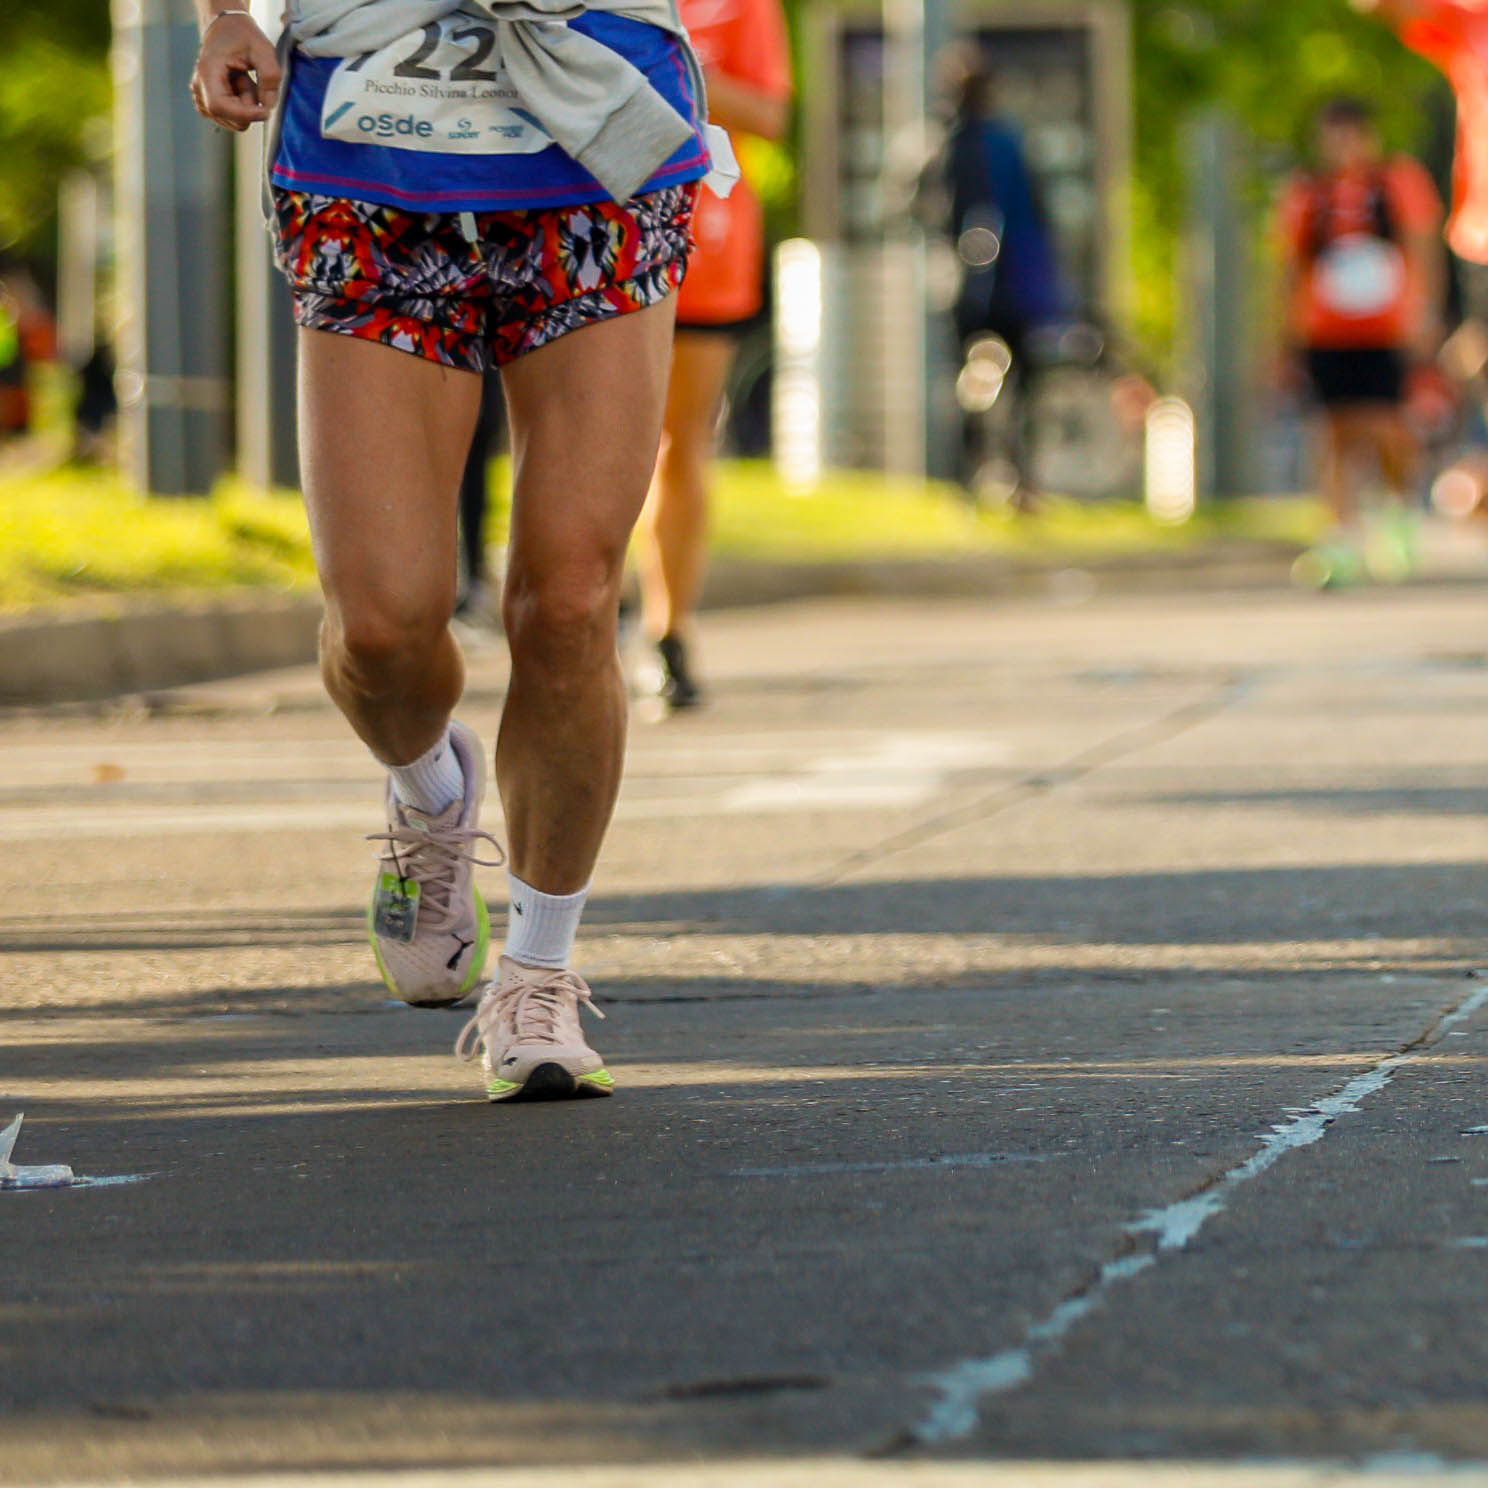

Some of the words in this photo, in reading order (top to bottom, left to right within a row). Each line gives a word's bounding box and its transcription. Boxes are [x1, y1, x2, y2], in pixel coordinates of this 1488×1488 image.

[365, 79, 416, 96] Picchio
[419, 84, 467, 99] Silvina
[357, 113, 434, 138] osde
